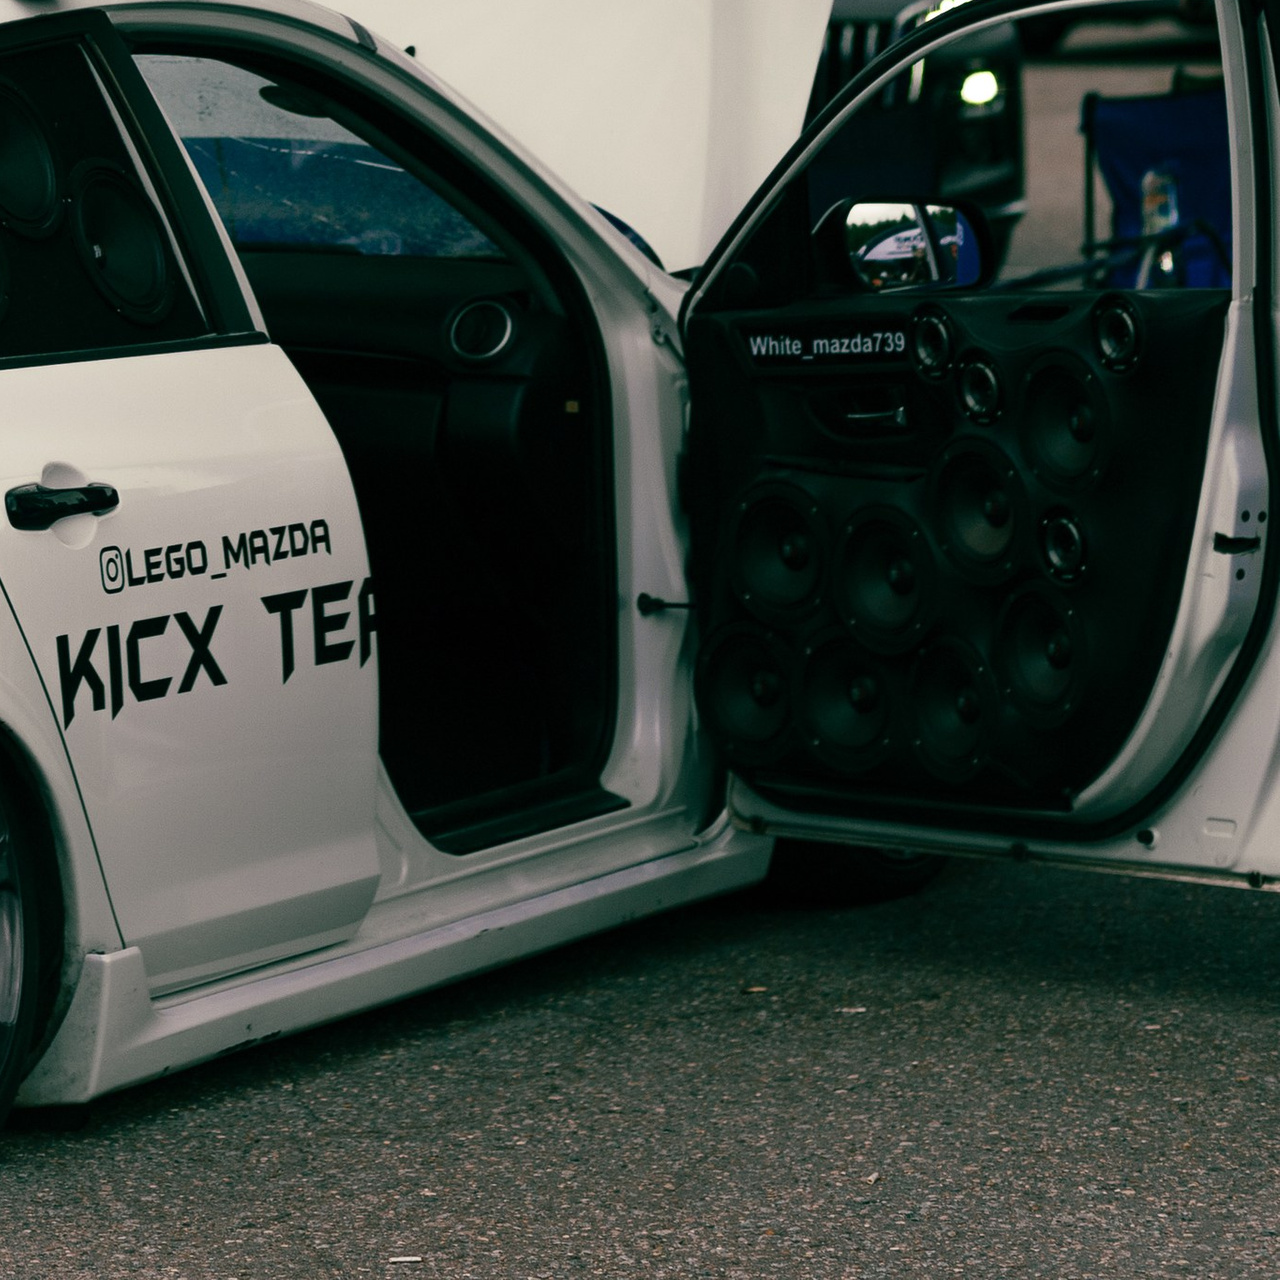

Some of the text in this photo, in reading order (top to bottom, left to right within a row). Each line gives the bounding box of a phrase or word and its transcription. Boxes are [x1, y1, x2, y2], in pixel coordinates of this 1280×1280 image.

[749, 331, 906, 361] White_mazda739
[124, 518, 332, 587] LEGO_MAZDA
[55, 604, 228, 731] KICX
